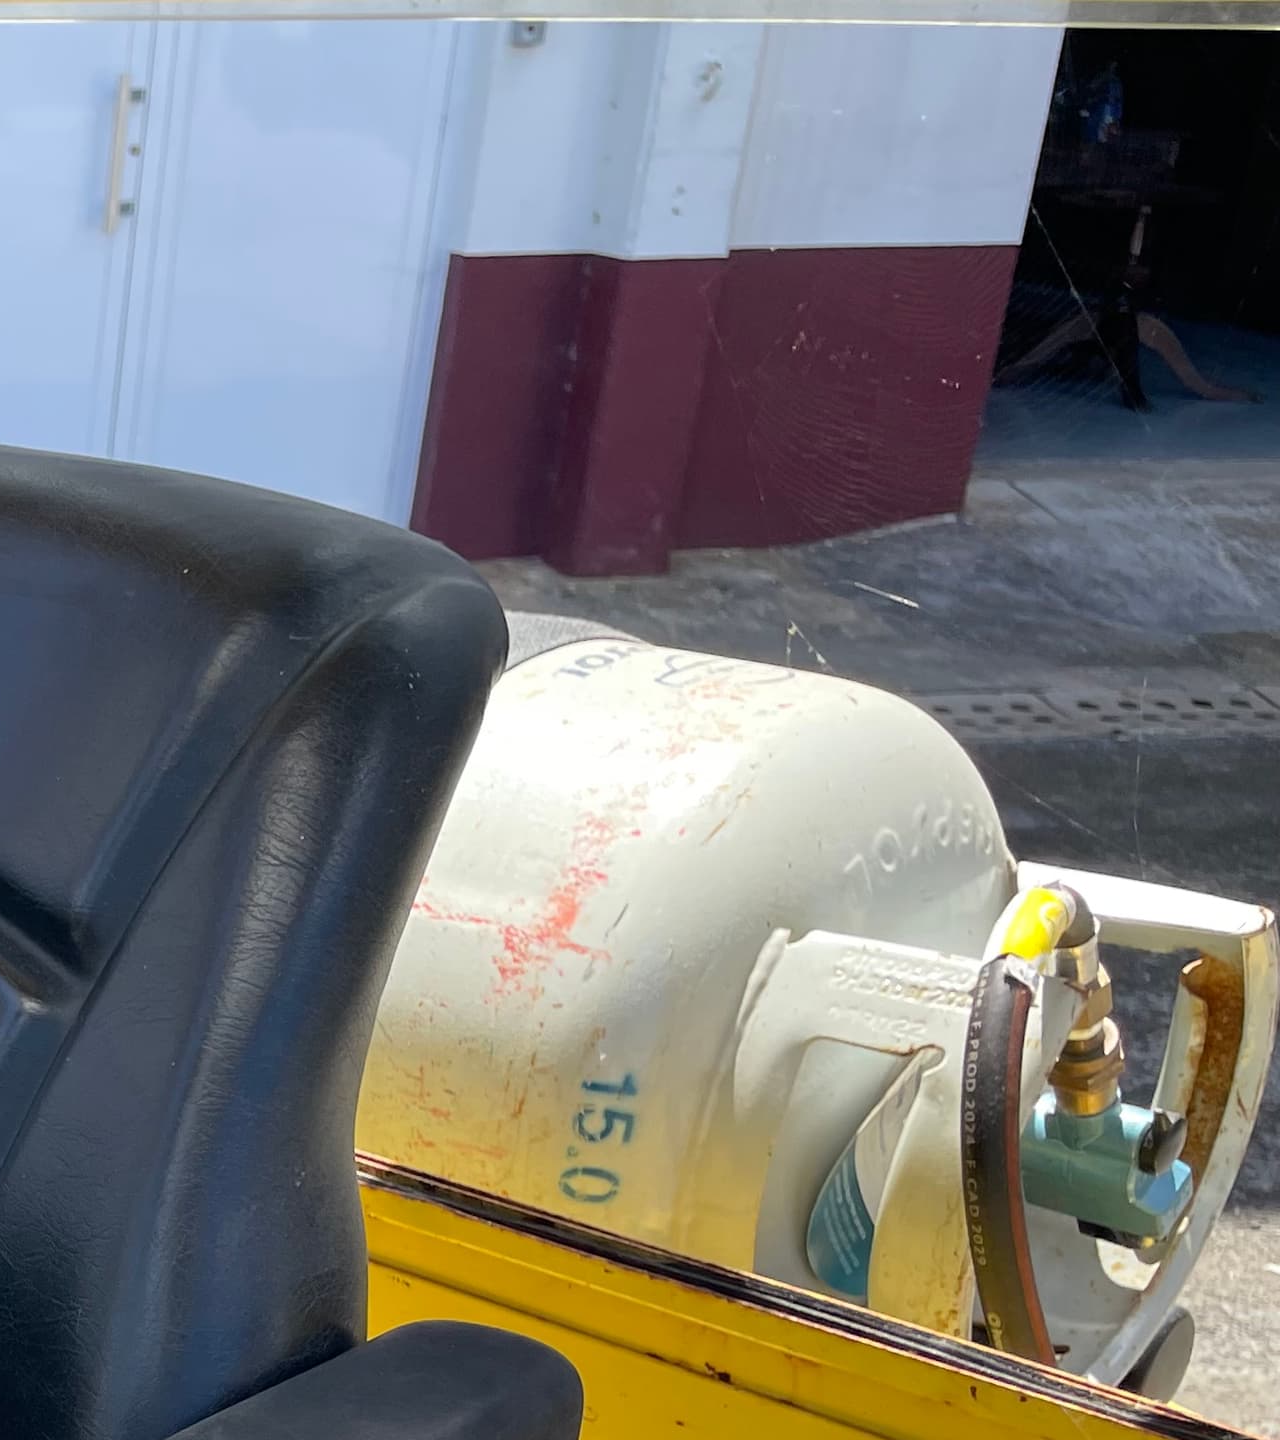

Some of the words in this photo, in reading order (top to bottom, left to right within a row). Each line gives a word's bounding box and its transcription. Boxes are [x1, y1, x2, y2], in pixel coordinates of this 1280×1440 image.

[558, 1072, 638, 1202] 15.0
[963, 1101, 976, 1145] 2024
[970, 1224, 988, 1267] 2029
